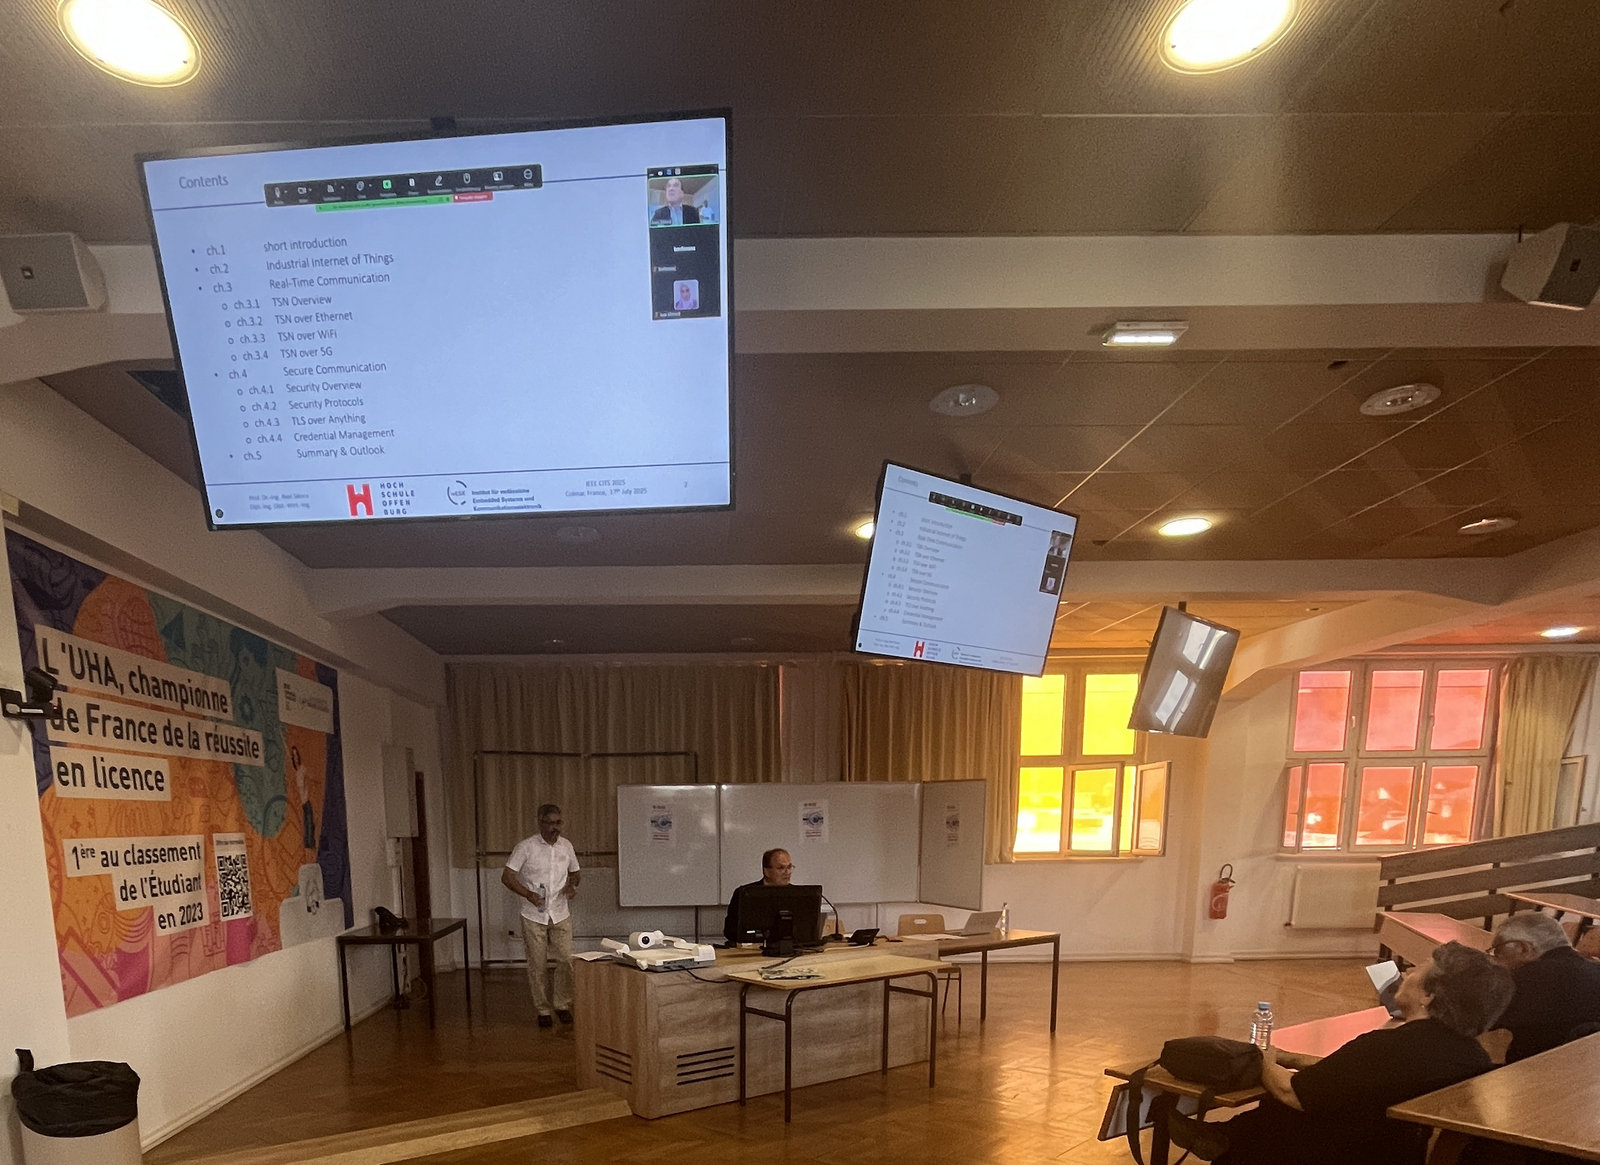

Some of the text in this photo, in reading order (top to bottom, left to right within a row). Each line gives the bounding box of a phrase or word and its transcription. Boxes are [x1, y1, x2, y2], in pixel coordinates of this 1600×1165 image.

[178, 174, 229, 189] Contents
[205, 236, 348, 256] ch.1 short introduction
[209, 252, 394, 275] ch.2 Industrial Internet of Things
[212, 272, 390, 293] ch.3 Real-Time Communication
[233, 295, 332, 310] ch.3.1 TSN Overview
[236, 311, 353, 327] ch.3.2 TSN over Ethernet
[239, 333, 266, 344] ch.3.3
[277, 331, 295, 342] TSN
[296, 331, 316, 341] over
[242, 345, 333, 361] ch.3.4 TSN over 5G
[228, 361, 387, 379] ch.4 Secure Communication
[248, 381, 362, 395] ch.4.1 Security Overview
[251, 396, 364, 412] ch.4.2 Security Protocols
[254, 413, 366, 428] ch.4.3 TLS over Anything
[257, 428, 395, 444] ch.4.4 Credential Management
[243, 444, 385, 461] ch.5 Summary & Outlook
[379, 481, 405, 490] HOCH
[380, 489, 415, 499] SCHULE
[381, 498, 411, 507] OFFEN
[383, 507, 407, 516] BURG
[42, 637, 125, 696] L'UHA,
[128, 664, 229, 713] championne
[86, 703, 157, 745] France
[163, 718, 184, 748] de
[188, 722, 201, 751] la
[204, 724, 260, 759] réussite
[56, 755, 165, 792] en licence
[71, 841, 202, 870] 1ère au classement
[119, 869, 202, 902] de l'Étudiant
[157, 901, 204, 930] en 2023
